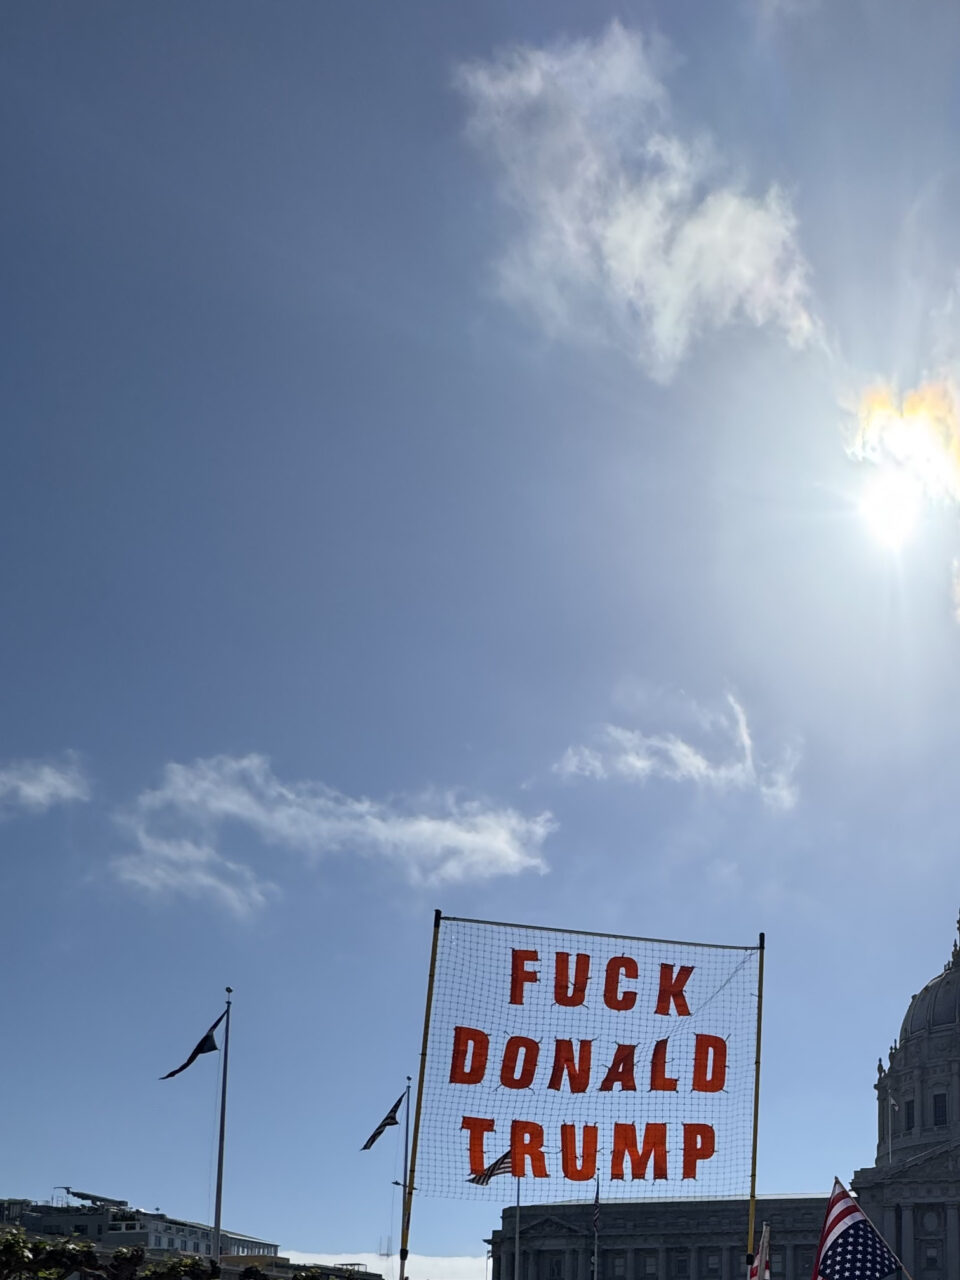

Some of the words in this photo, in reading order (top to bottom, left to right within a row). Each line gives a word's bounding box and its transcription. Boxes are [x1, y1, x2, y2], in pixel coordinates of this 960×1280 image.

[510, 949, 694, 1016] FUCK
[449, 1026, 728, 1093] DONALD
[461, 1117, 716, 1182] TRUMP
